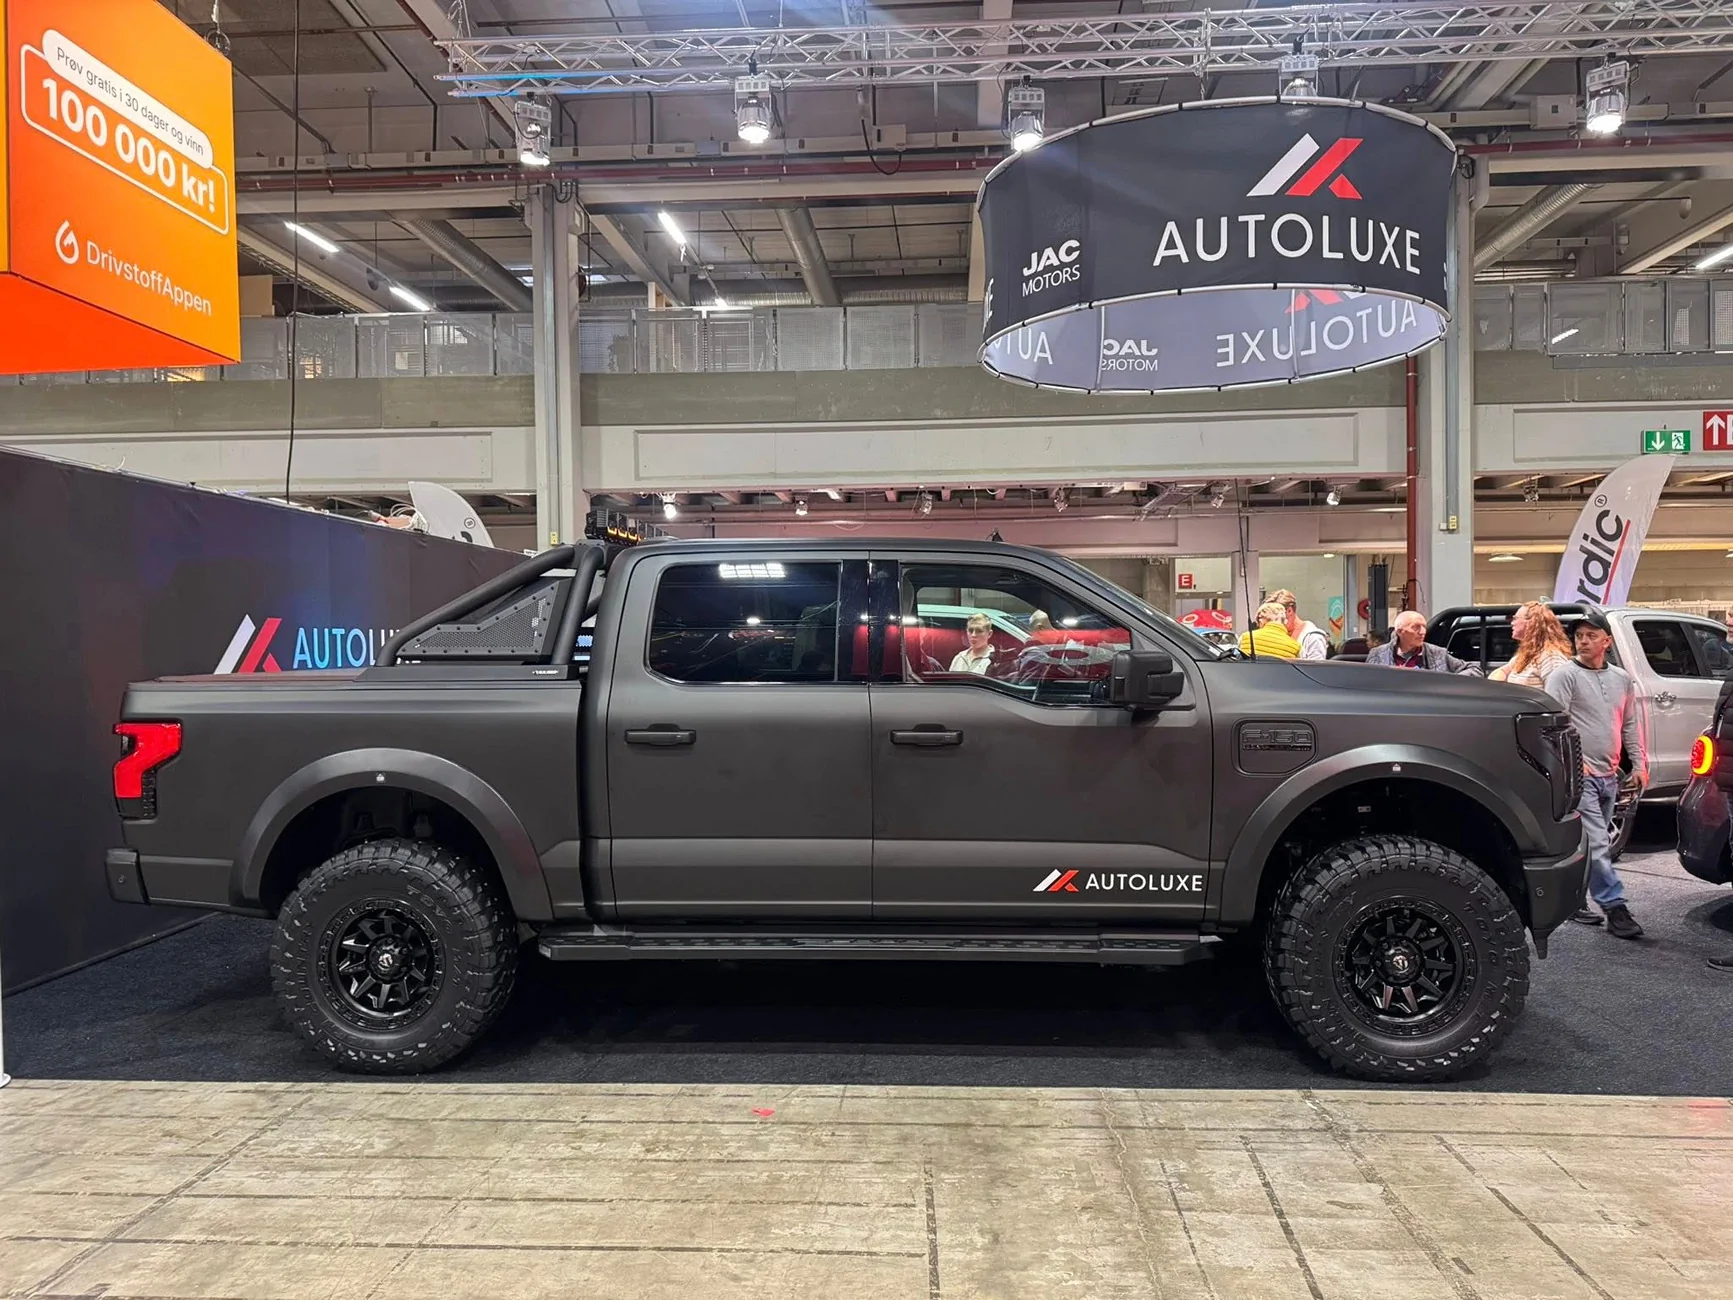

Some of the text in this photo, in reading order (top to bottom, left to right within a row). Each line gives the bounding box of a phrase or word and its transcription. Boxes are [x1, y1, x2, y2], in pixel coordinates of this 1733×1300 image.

[57, 46, 204, 157] Prøv gratis i 30 dager og vinn
[42, 77, 216, 213] 100 000 kr!
[1022, 239, 1080, 277] JAC
[1153, 212, 1421, 275] AUTOLUXE
[87, 240, 212, 316] DrivstoffAppen
[1022, 264, 1081, 298] MOTORS
[1085, 873, 1203, 892] AUTOLUXE
